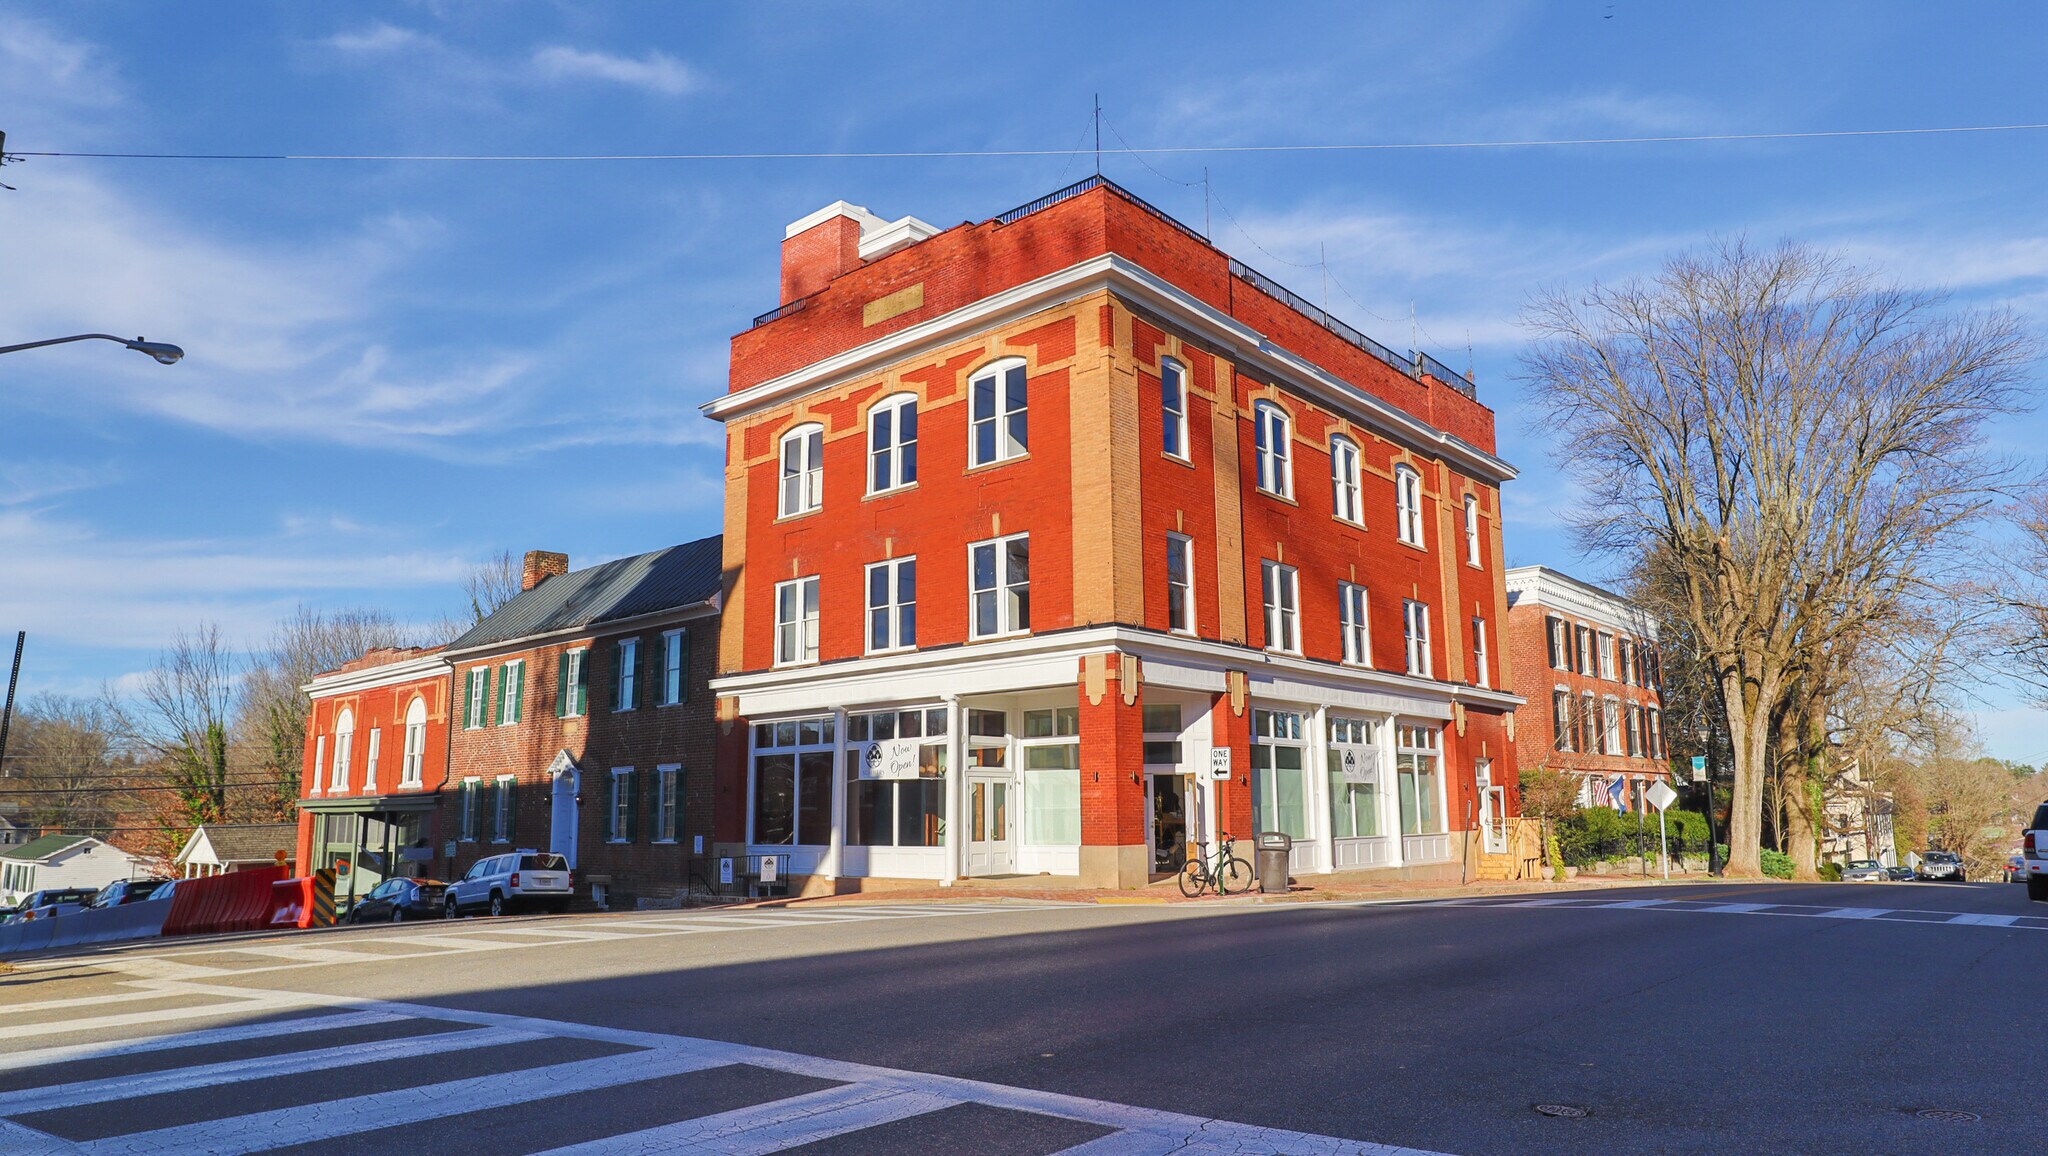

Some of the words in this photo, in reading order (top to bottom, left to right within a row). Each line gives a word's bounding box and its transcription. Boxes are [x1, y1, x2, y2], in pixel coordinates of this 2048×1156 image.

[890, 743, 912, 760] Now
[1213, 750, 1228, 758] ONE
[890, 754, 916, 777] Open!
[1213, 758, 1228, 767] WAY
